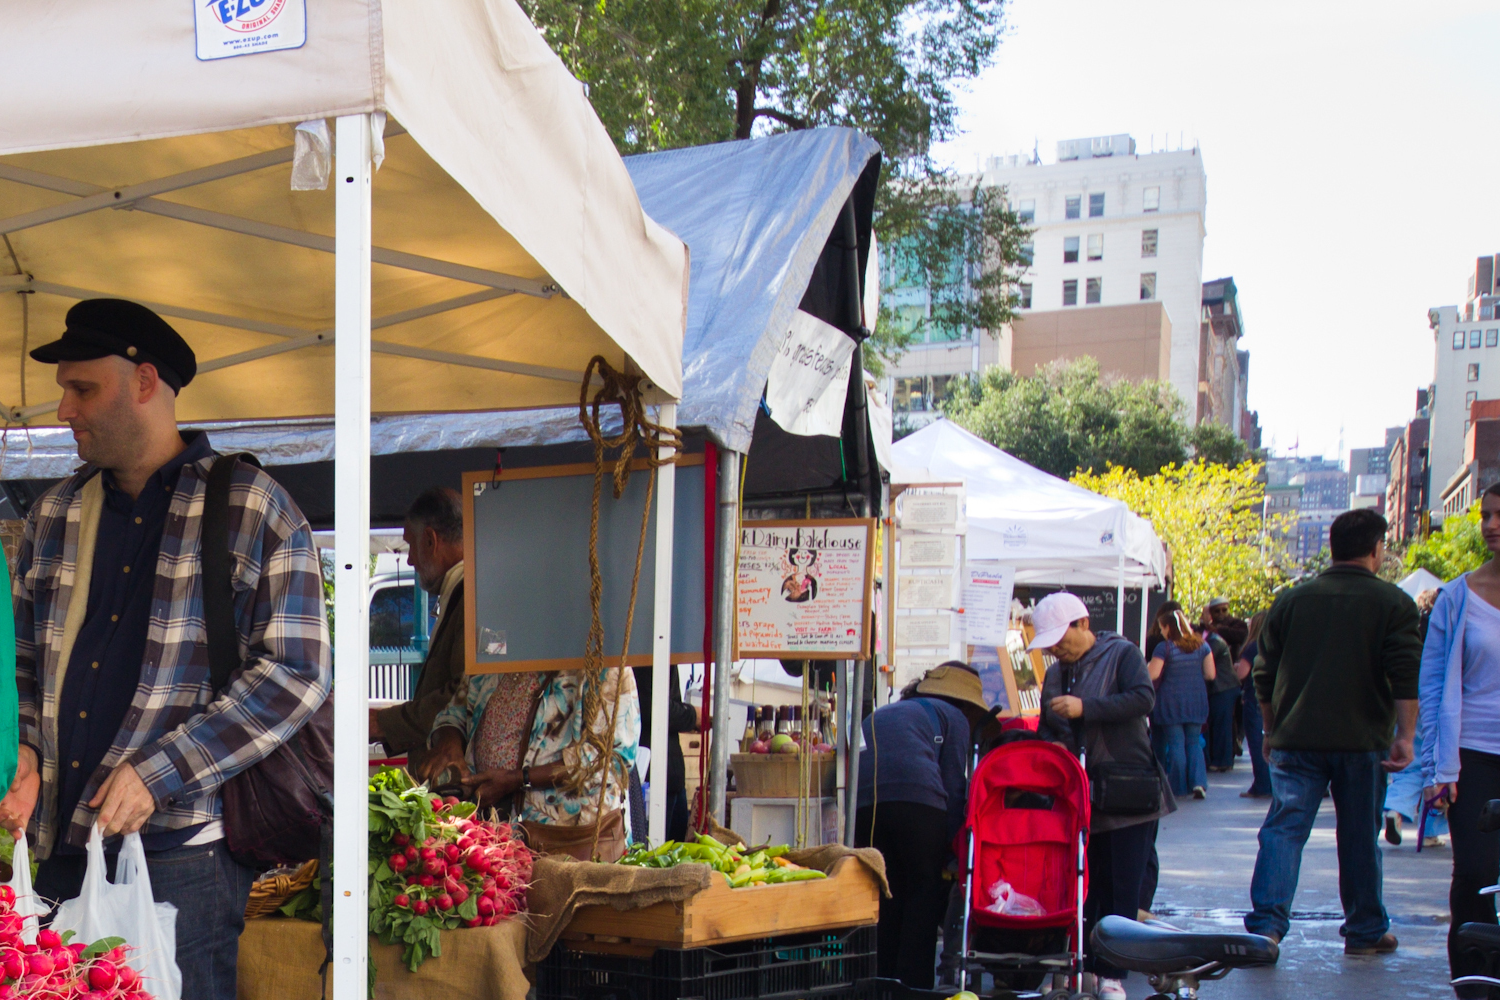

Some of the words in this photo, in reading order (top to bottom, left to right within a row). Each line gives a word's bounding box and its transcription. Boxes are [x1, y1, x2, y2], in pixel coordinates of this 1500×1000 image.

[242, 15, 271, 29] ORIGINAL
[223, 33, 279, 46] www.ezup.com
[753, 529, 788, 549] Dairy
[795, 528, 861, 548] Bakehouse
[741, 588, 771, 598] summery
[753, 621, 775, 631] grape
